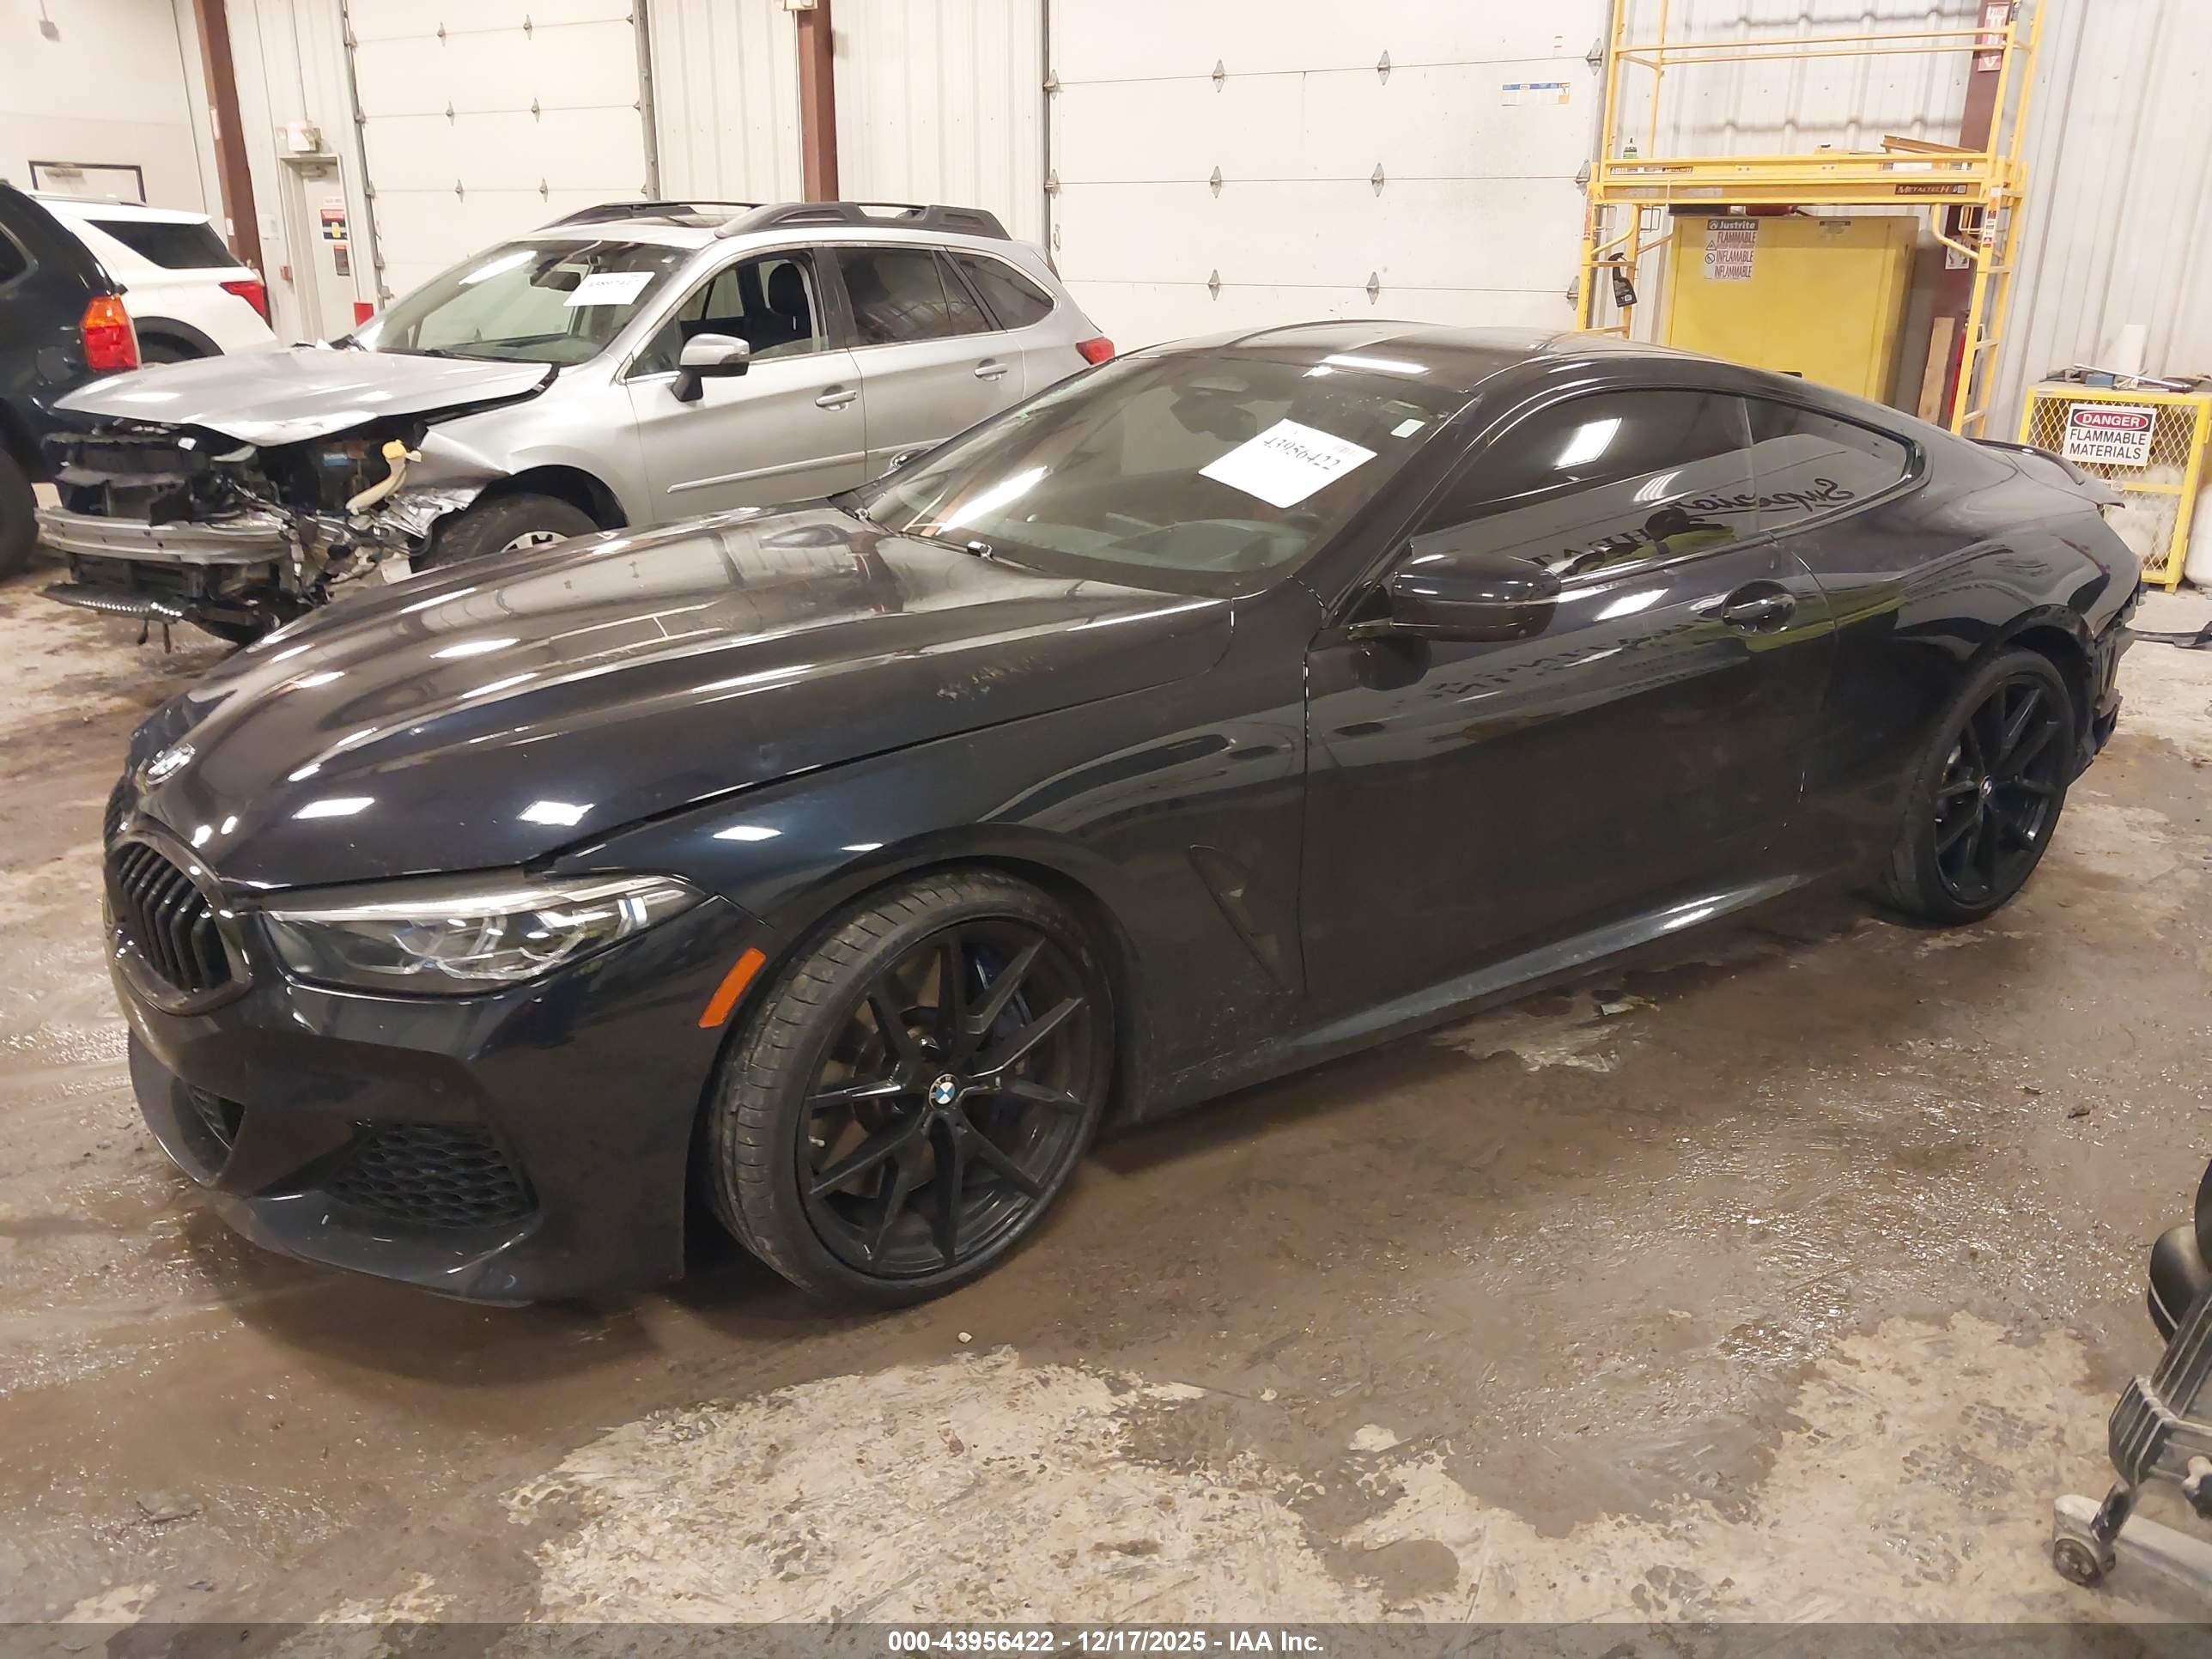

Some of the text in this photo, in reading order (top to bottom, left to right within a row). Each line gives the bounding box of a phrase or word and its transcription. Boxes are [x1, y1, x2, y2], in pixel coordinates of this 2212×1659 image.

[1719, 221, 1756, 230] Justrite
[1717, 232, 1756, 243] FLAMMABLE
[1716, 251, 1753, 263] INFLAMABLE
[1714, 265, 1753, 277] INFLAMMABLE
[2081, 413, 2141, 428] DANGER
[2069, 428, 2147, 446] FLAMMABLE
[1264, 436, 1340, 471] 43956422
[2069, 443, 2142, 459] MATERIALS
